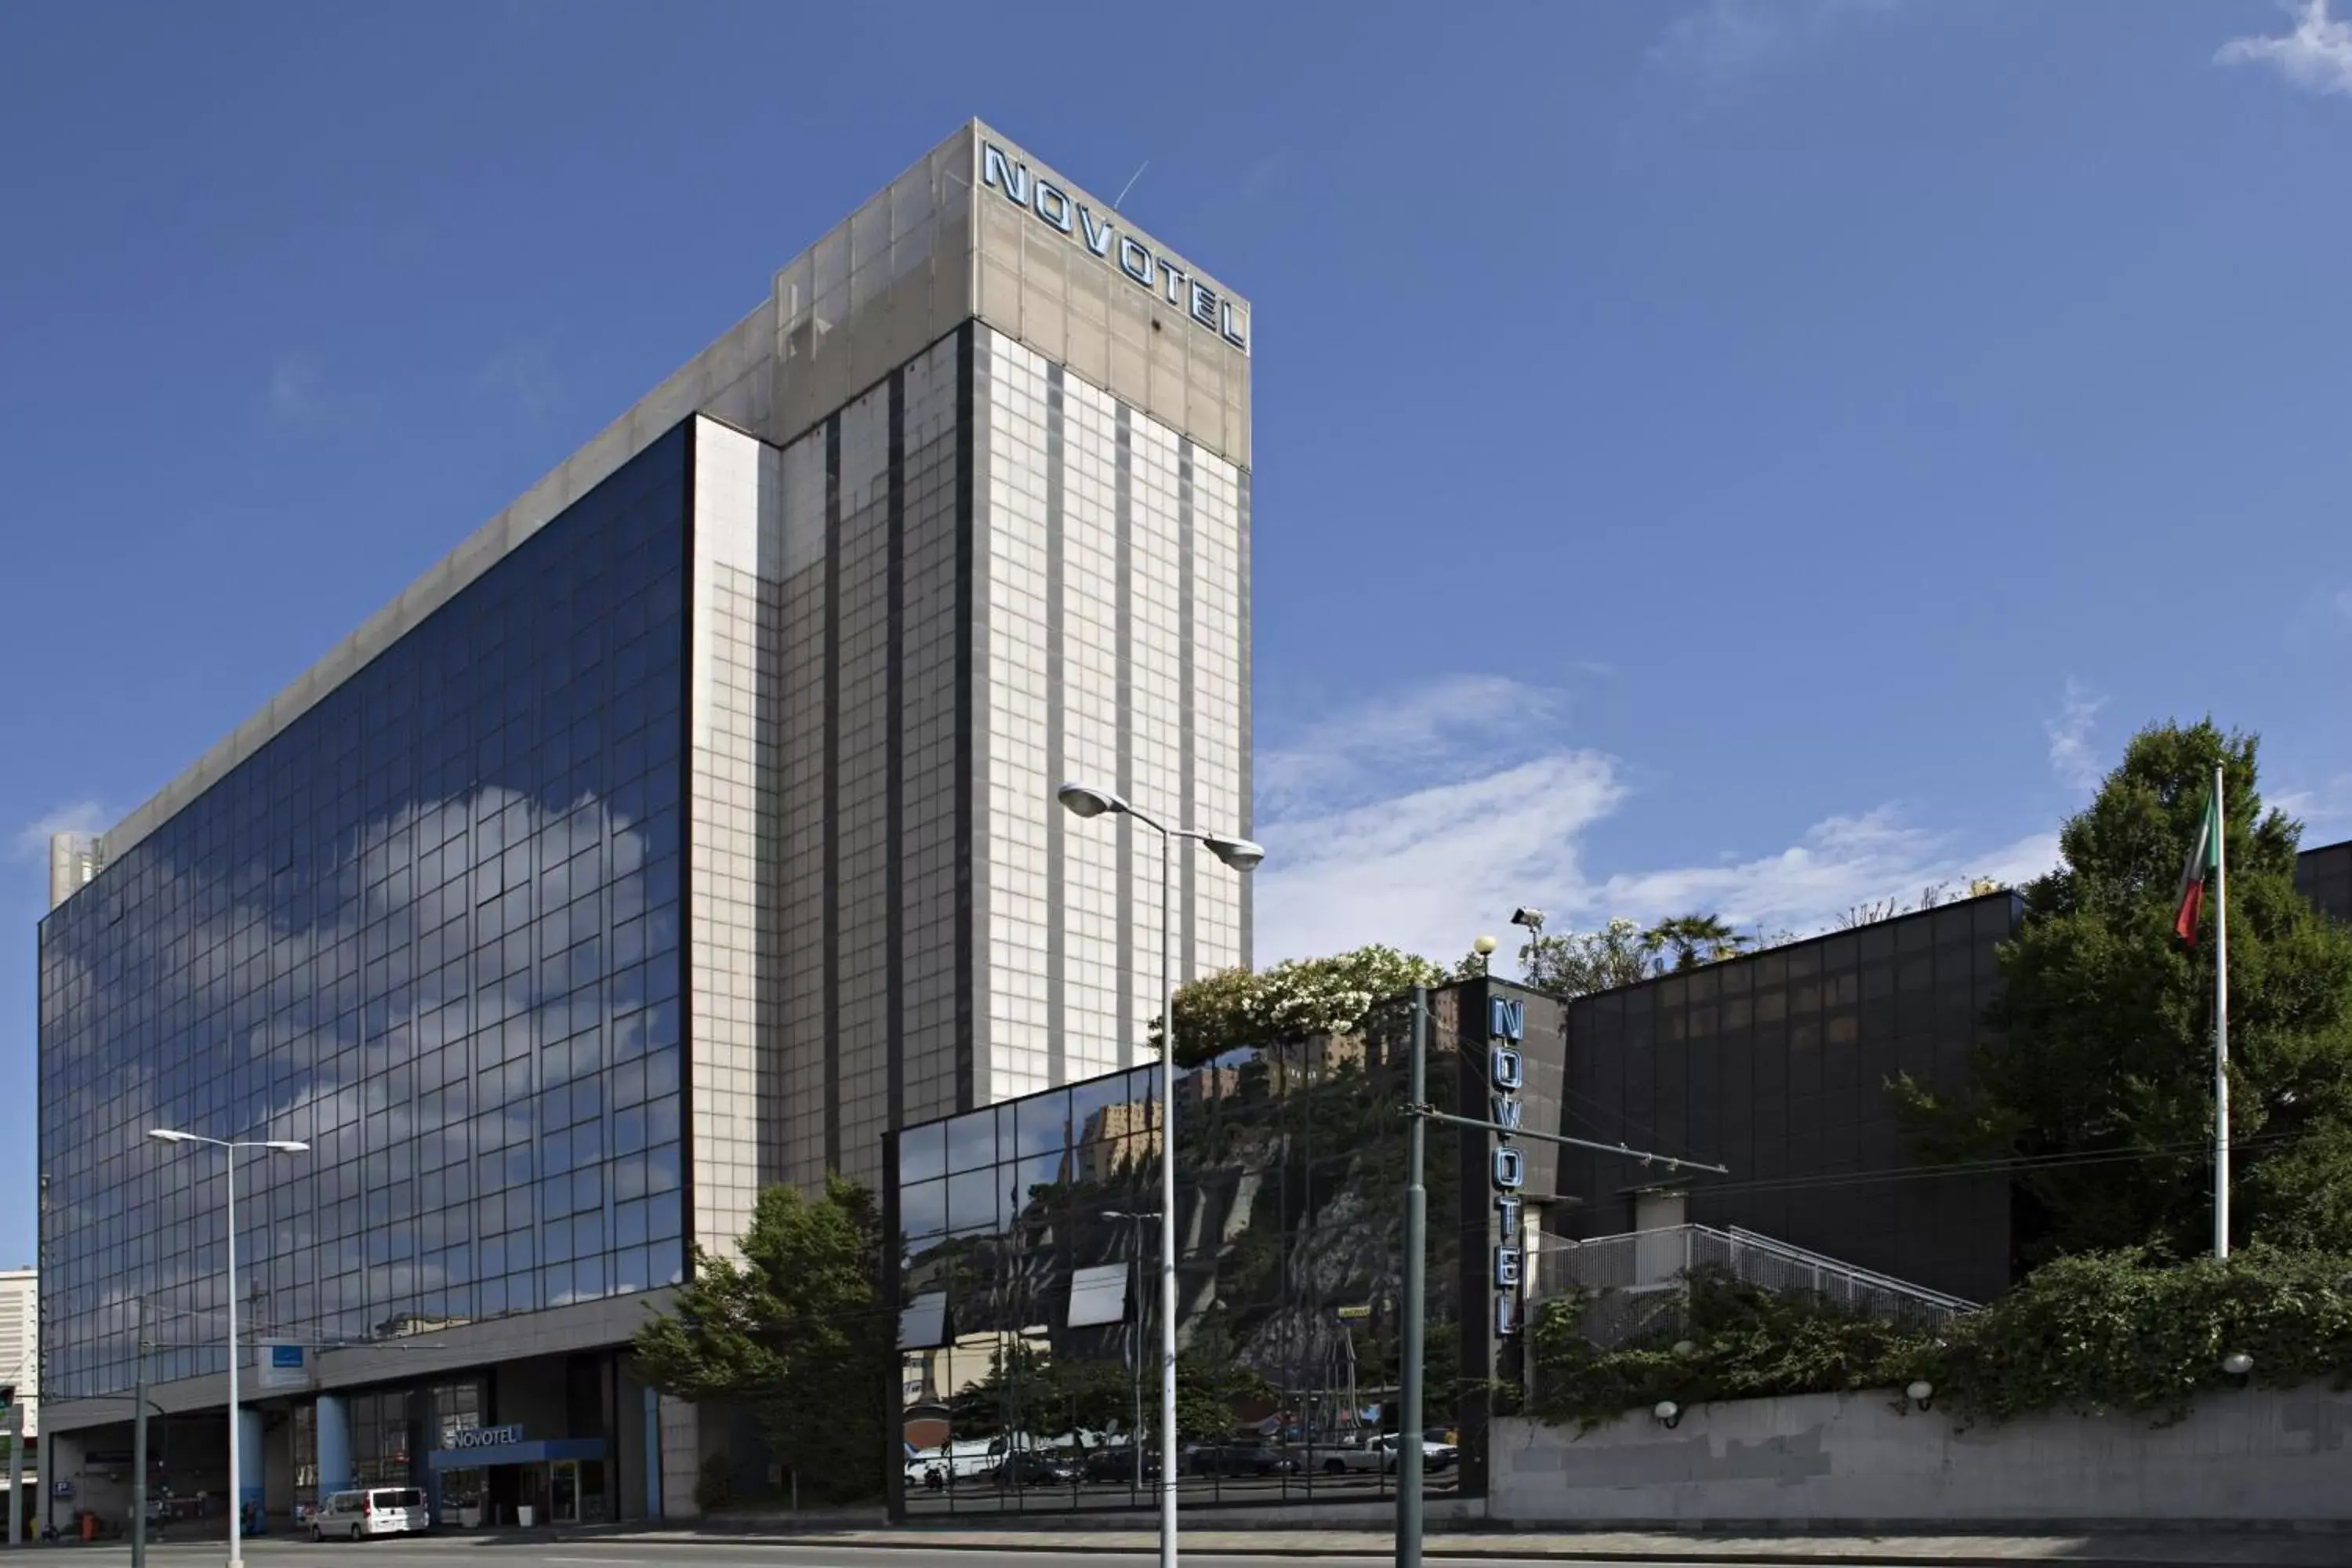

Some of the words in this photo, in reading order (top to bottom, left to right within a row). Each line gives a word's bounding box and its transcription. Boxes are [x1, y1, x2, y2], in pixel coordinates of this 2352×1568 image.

[983, 140, 1247, 348] NOVOTEL
[1491, 993, 1523, 1334] NOVOTEL
[454, 1427, 517, 1447] NOVOTEL
